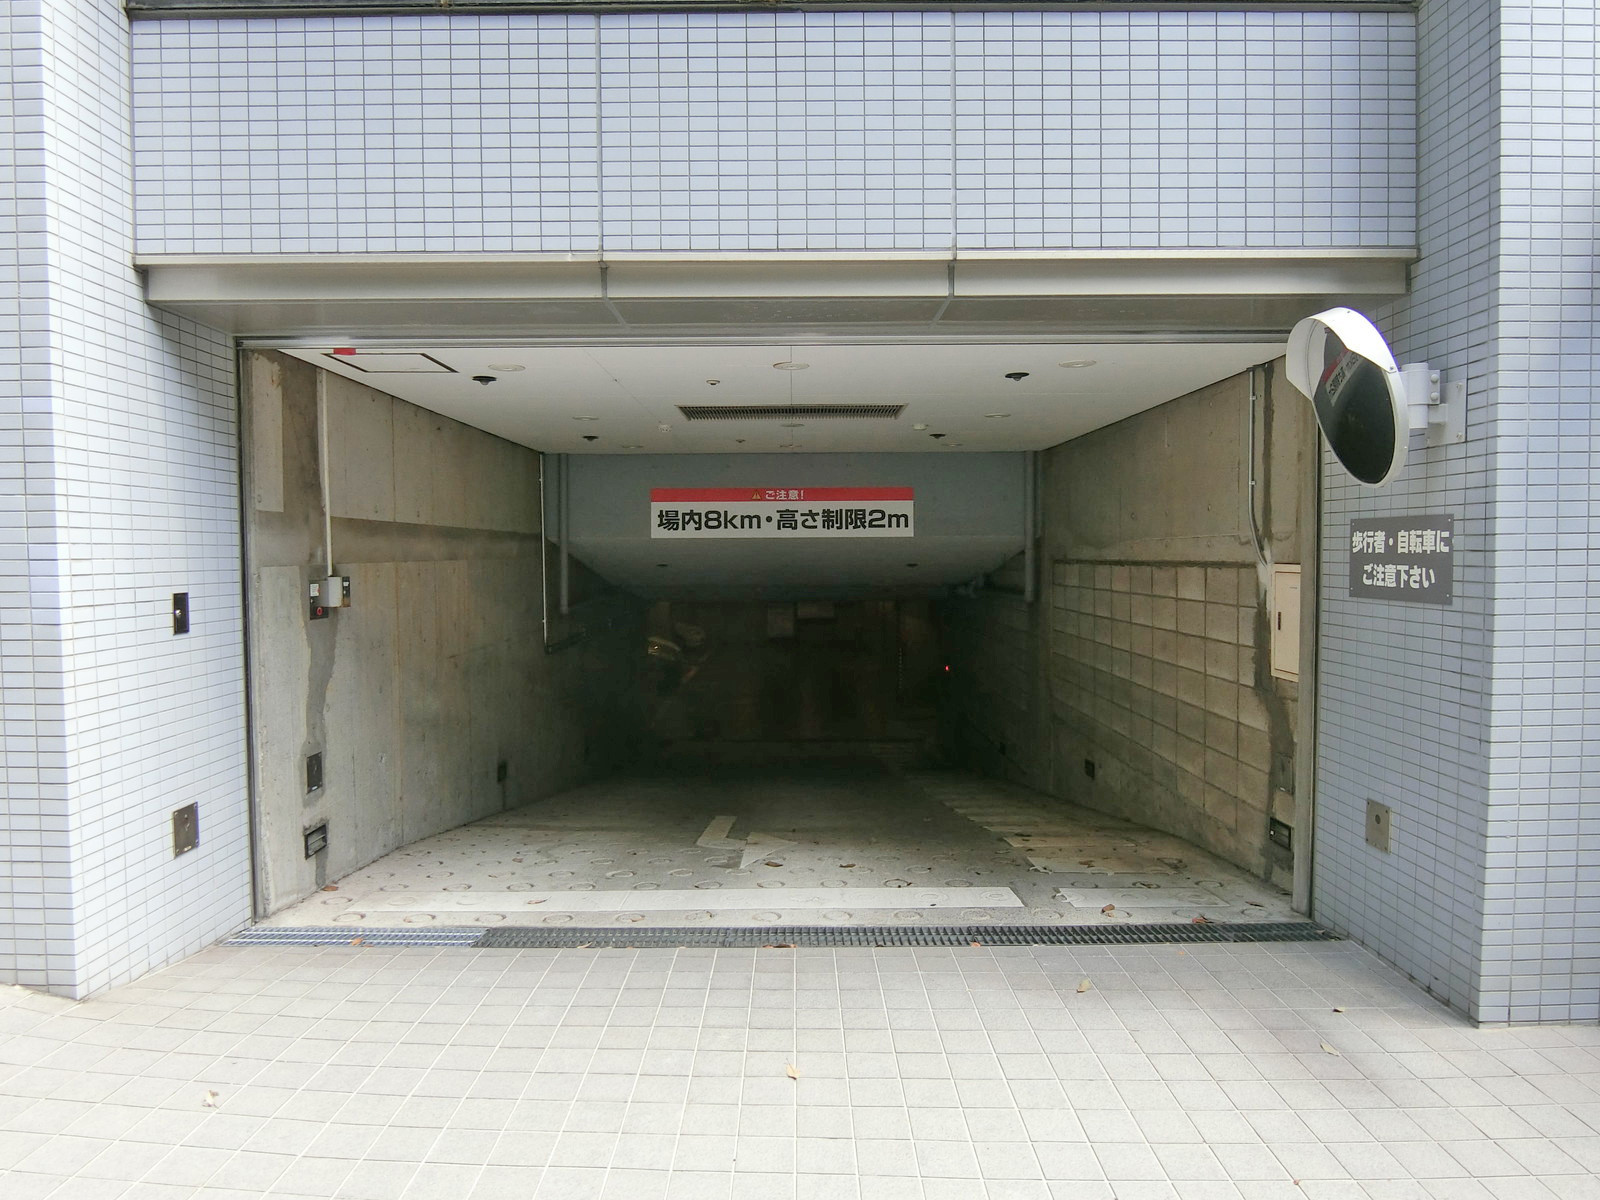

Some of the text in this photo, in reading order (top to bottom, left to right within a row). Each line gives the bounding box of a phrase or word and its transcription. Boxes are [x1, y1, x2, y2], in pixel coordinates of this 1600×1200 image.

[657, 508, 909, 531] 場内8km・高さ制限2m
[1352, 529, 1450, 554] 歩行者・自転車に
[1362, 563, 1436, 589] ご注意下さい
